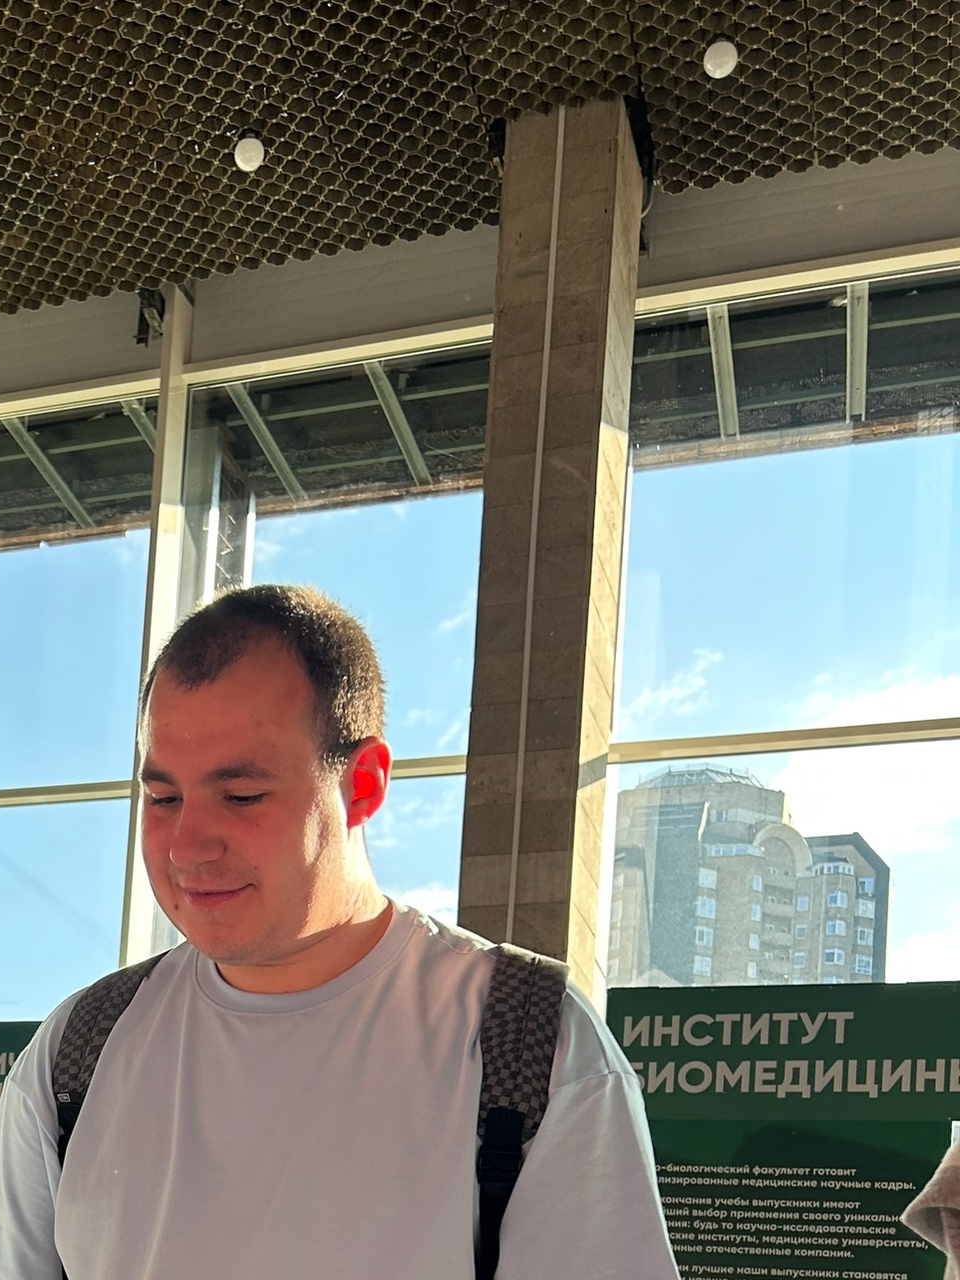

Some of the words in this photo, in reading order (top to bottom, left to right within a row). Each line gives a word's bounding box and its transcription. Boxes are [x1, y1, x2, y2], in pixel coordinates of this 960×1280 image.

[623, 1011, 855, 1047] ИНСТИТУТ
[753, 1165, 810, 1176] факультет
[813, 1168, 856, 1176] готовит
[742, 1178, 817, 1188] медицинские
[821, 1180, 871, 1190] научные
[874, 1182, 916, 1191] кадры.
[714, 1197, 749, 1208] учебы
[752, 1199, 820, 1209] выпускники
[822, 1201, 860, 1209] имеют
[692, 1208, 727, 1219] выбор
[730, 1210, 799, 1220] применения
[802, 1213, 841, 1221] своего
[693, 1220, 718, 1231] будь
[721, 1222, 734, 1230] то
[736, 1222, 897, 1235] научно-исследовательские
[697, 1234, 759, 1245] институты,
[762, 1236, 839, 1247] медицинские
[841, 1238, 929, 1249] университеты,
[705, 1245, 792, 1256] отечественные
[794, 1248, 855, 1258] компании.
[691, 1265, 734, 1275] лучшие
[737, 1267, 768, 1275] наши
[770, 1268, 839, 1279] выпускники
[842, 1271, 908, 1280] становятся
